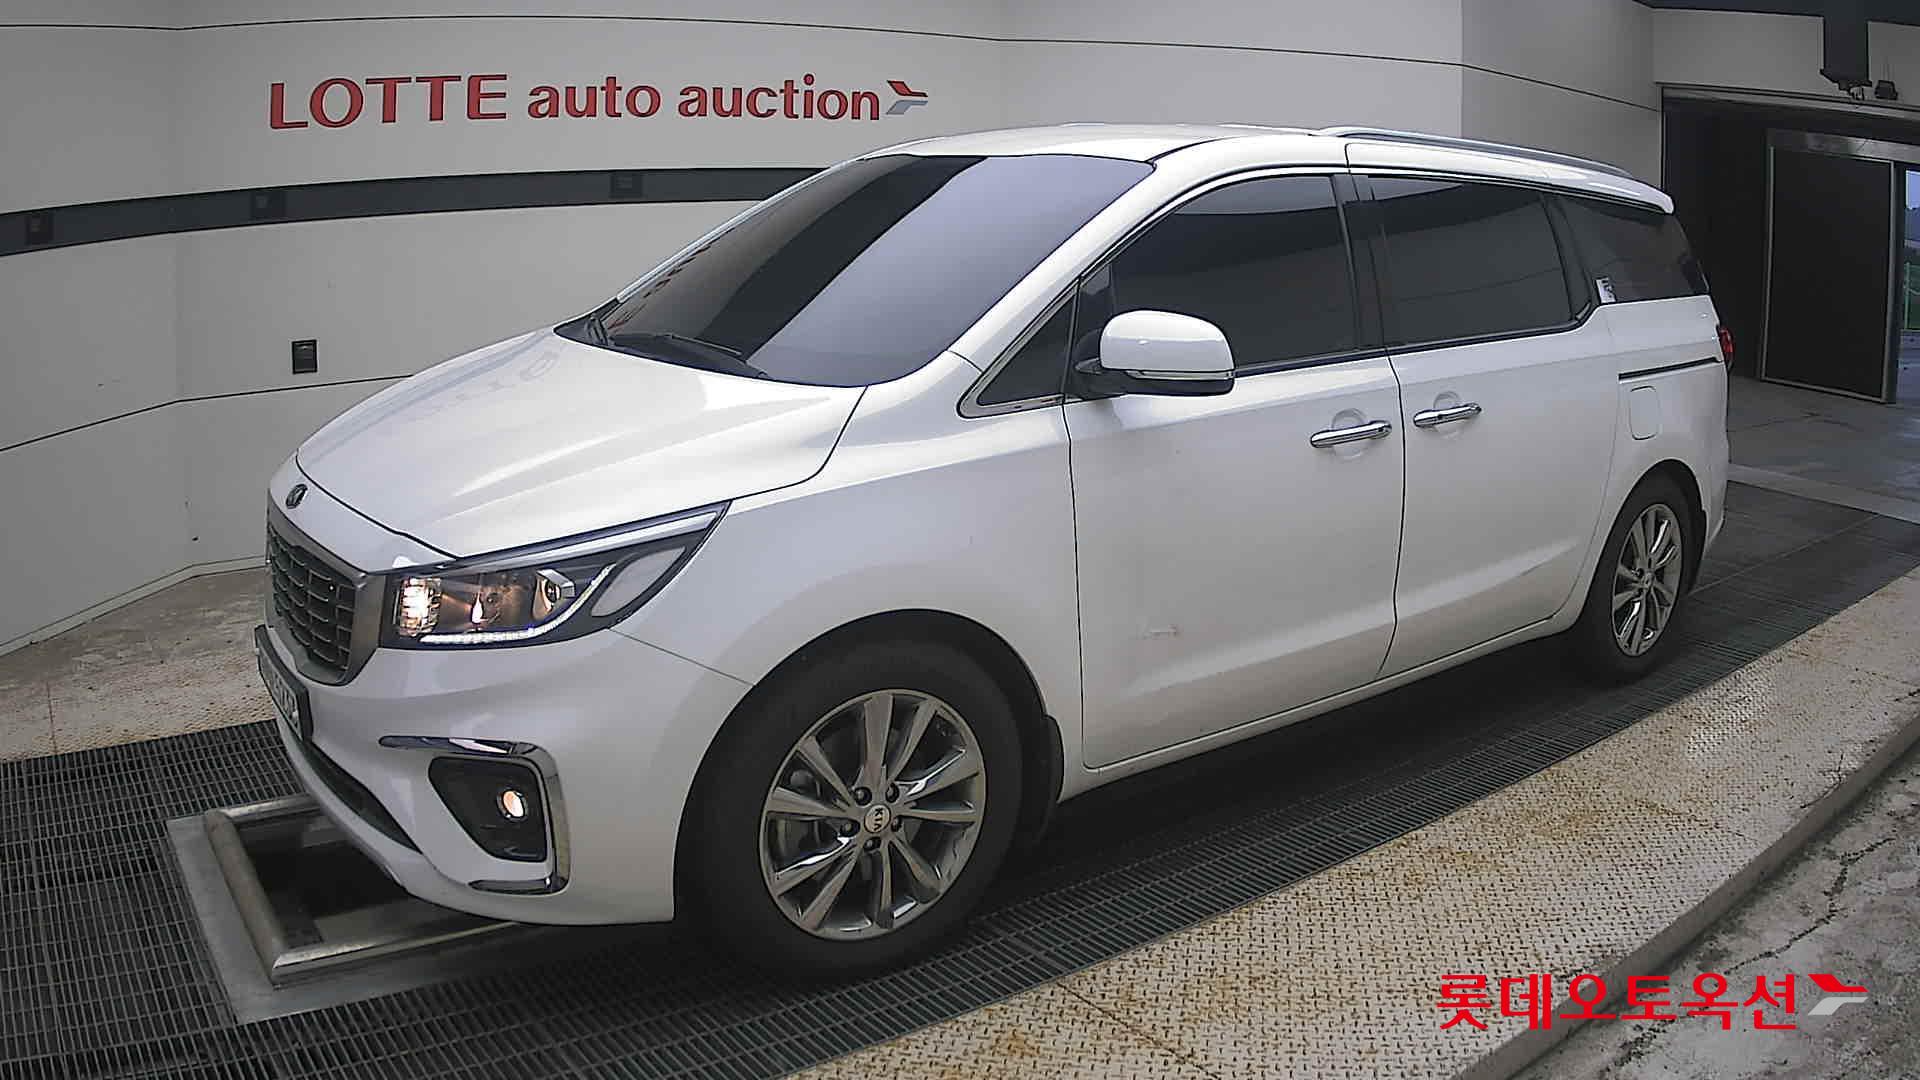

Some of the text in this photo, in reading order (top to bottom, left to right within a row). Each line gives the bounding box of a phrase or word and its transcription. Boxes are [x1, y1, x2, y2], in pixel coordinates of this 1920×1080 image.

[270, 73, 881, 130] LOTTE auto auction
